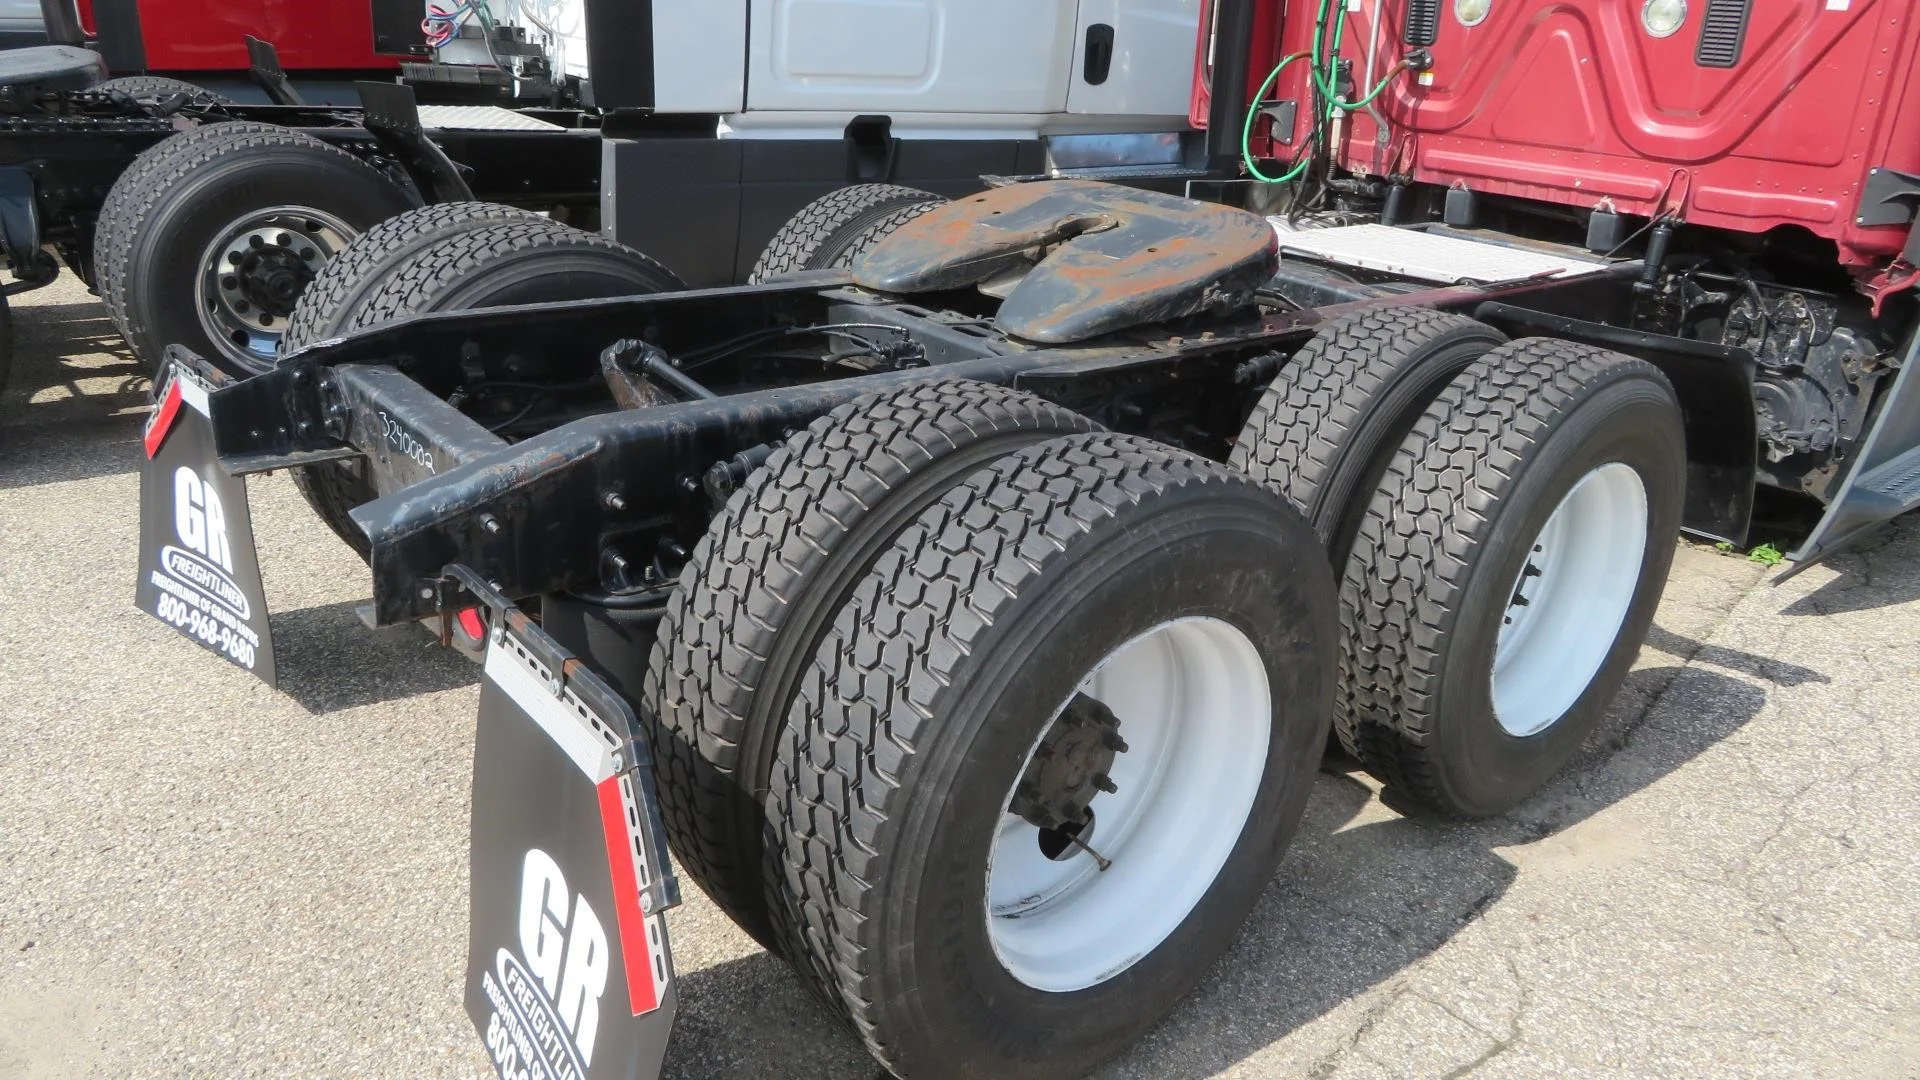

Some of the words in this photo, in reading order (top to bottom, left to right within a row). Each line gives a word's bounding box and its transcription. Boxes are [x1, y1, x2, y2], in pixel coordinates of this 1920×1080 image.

[175, 466, 233, 575] GR
[151, 570, 201, 608] FREIGHTLINER
[200, 597, 212, 613] OF
[211, 603, 237, 630] GRAND
[158, 592, 255, 669] 800-968-9680
[170, 554, 244, 611] FREIGHTLINER
[519, 848, 609, 1069] GR
[482, 970, 534, 1070] FREIGHTLINER
[507, 967, 576, 1080] FREIGHTLI
